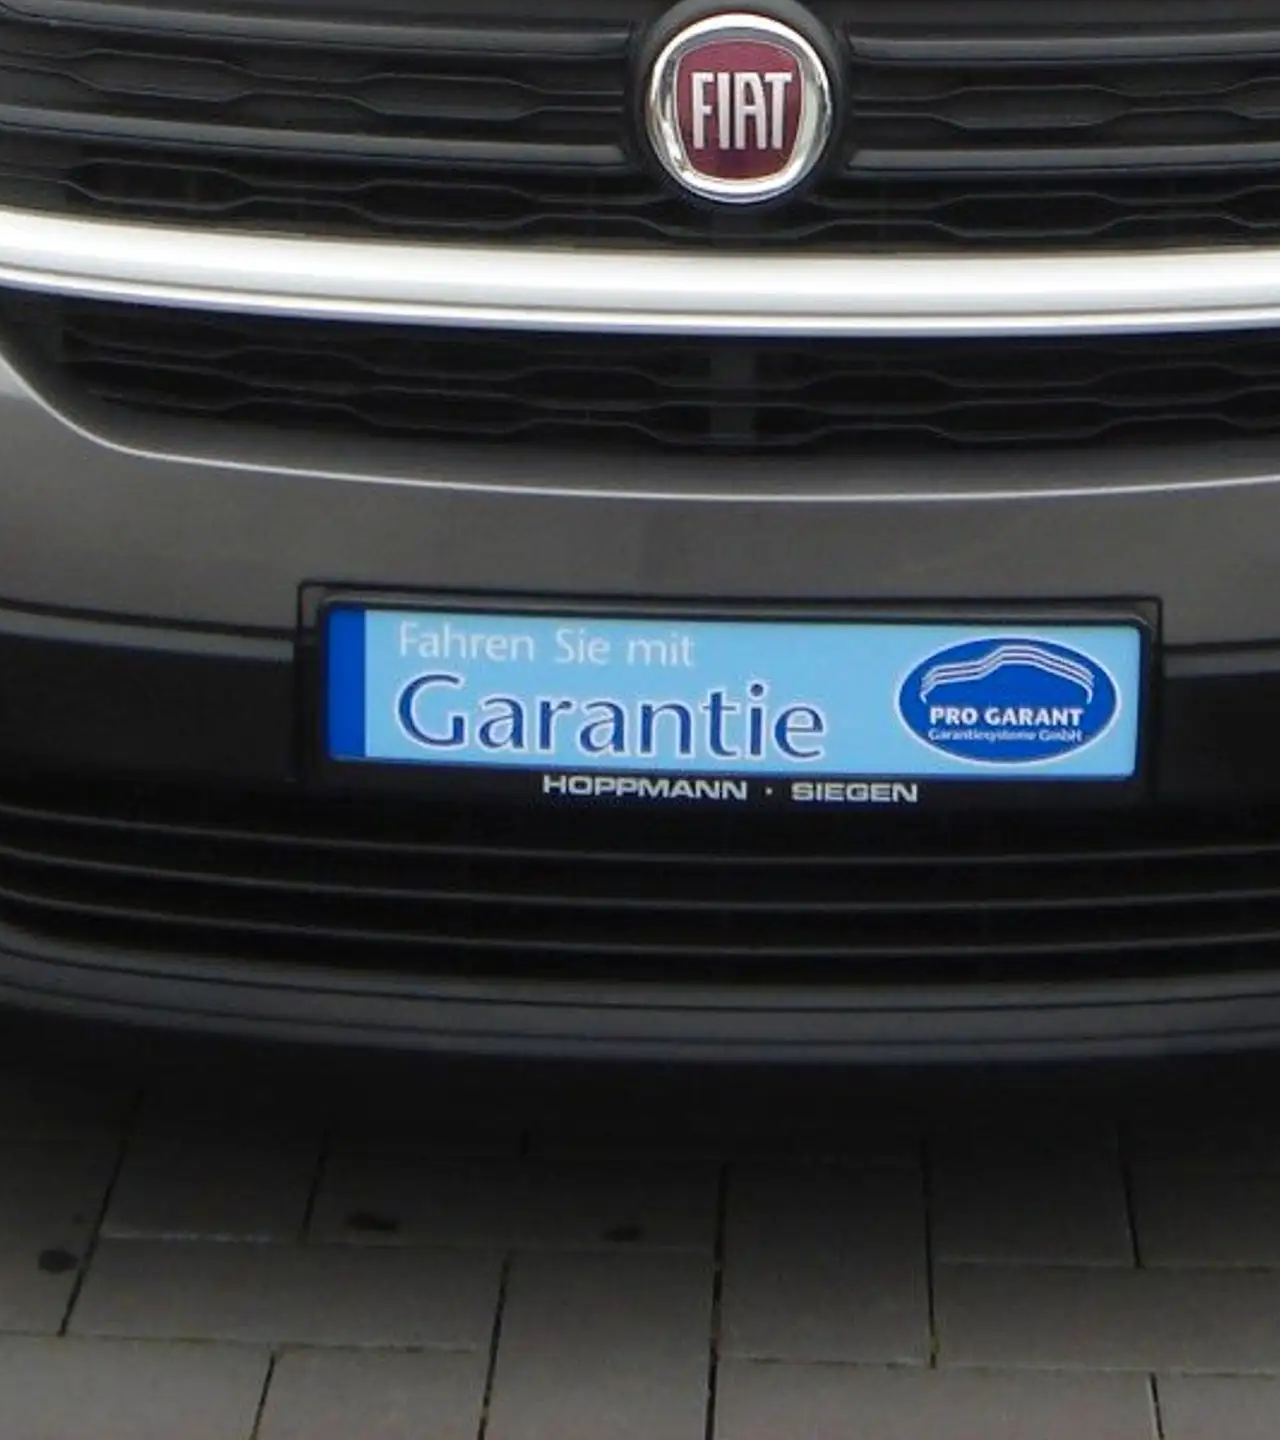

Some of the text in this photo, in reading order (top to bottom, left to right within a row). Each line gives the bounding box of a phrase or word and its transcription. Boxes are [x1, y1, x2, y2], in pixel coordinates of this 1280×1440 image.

[691, 72, 792, 150] FIAT
[399, 620, 696, 667] Fahren Sie mit
[396, 672, 825, 759] Garantie
[930, 707, 1084, 727] PRO GARANT
[543, 774, 919, 803] HOPPMANN SIEGEN
